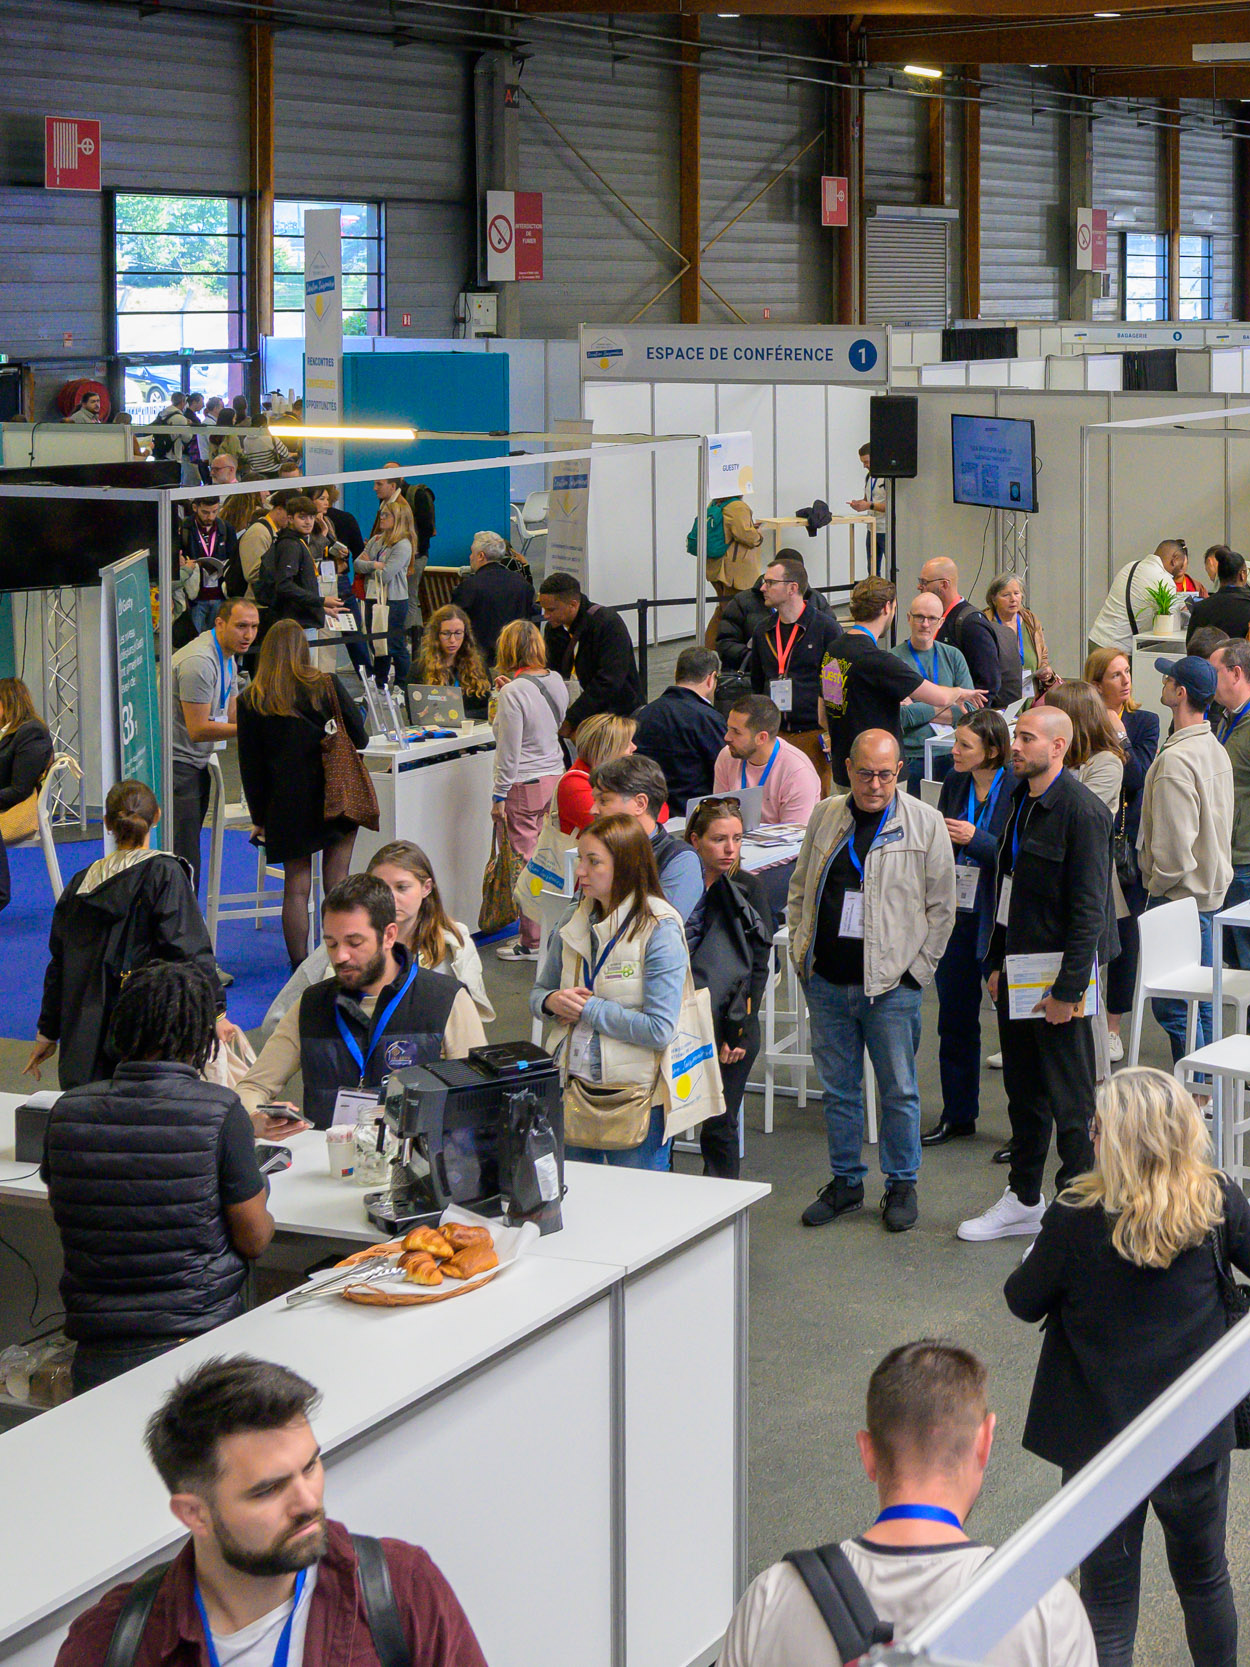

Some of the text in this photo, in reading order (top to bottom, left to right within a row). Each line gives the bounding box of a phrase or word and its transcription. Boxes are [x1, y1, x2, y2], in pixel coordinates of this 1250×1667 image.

[646, 344, 866, 364] ESPACE DE CONFÉRENCE 1
[307, 356, 334, 367] RENCONTRES
[722, 463, 740, 472] GUESTY
